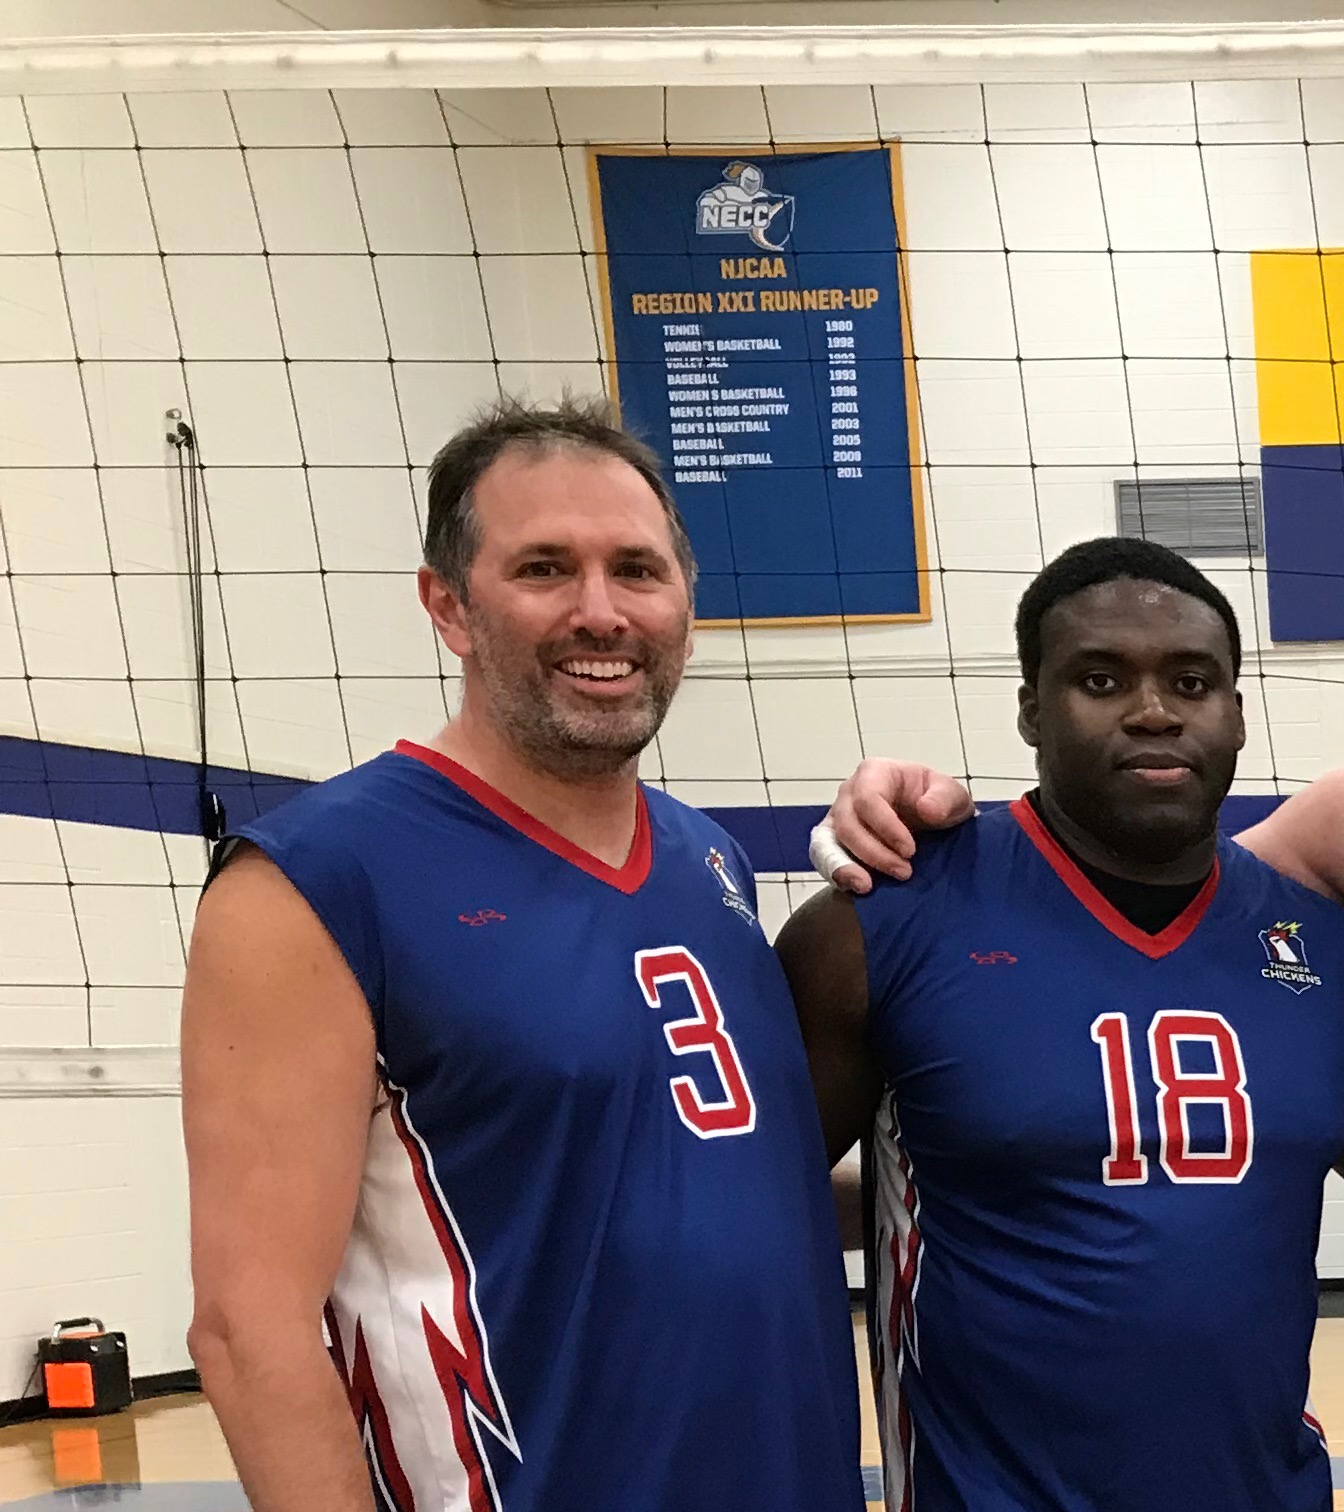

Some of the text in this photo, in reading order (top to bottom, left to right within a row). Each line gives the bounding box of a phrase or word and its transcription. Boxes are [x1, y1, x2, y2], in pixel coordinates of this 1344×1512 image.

[701, 203, 771, 229] NECC
[720, 257, 787, 280] NJCAA
[632, 287, 880, 315] REGION XXI RUNNER-UP
[716, 338, 781, 351] BASKETBALL
[665, 356, 729, 369] VOLLEYALL
[667, 373, 720, 386] BASEBALL
[667, 389, 719, 402] WOMENS
[720, 386, 785, 400] BASKETBALL
[705, 405, 740, 418] CROSS
[741, 403, 790, 416] COUNTRY
[832, 402, 859, 414] 2001
[831, 418, 860, 430] 2003
[832, 434, 861, 446] 2005
[837, 467, 863, 479] 2011
[1269, 961, 1311, 974] THUNDER
[1261, 968, 1323, 986] CHICKENS
[634, 945, 756, 1140] 3
[1090, 1009, 1254, 1186] 18
